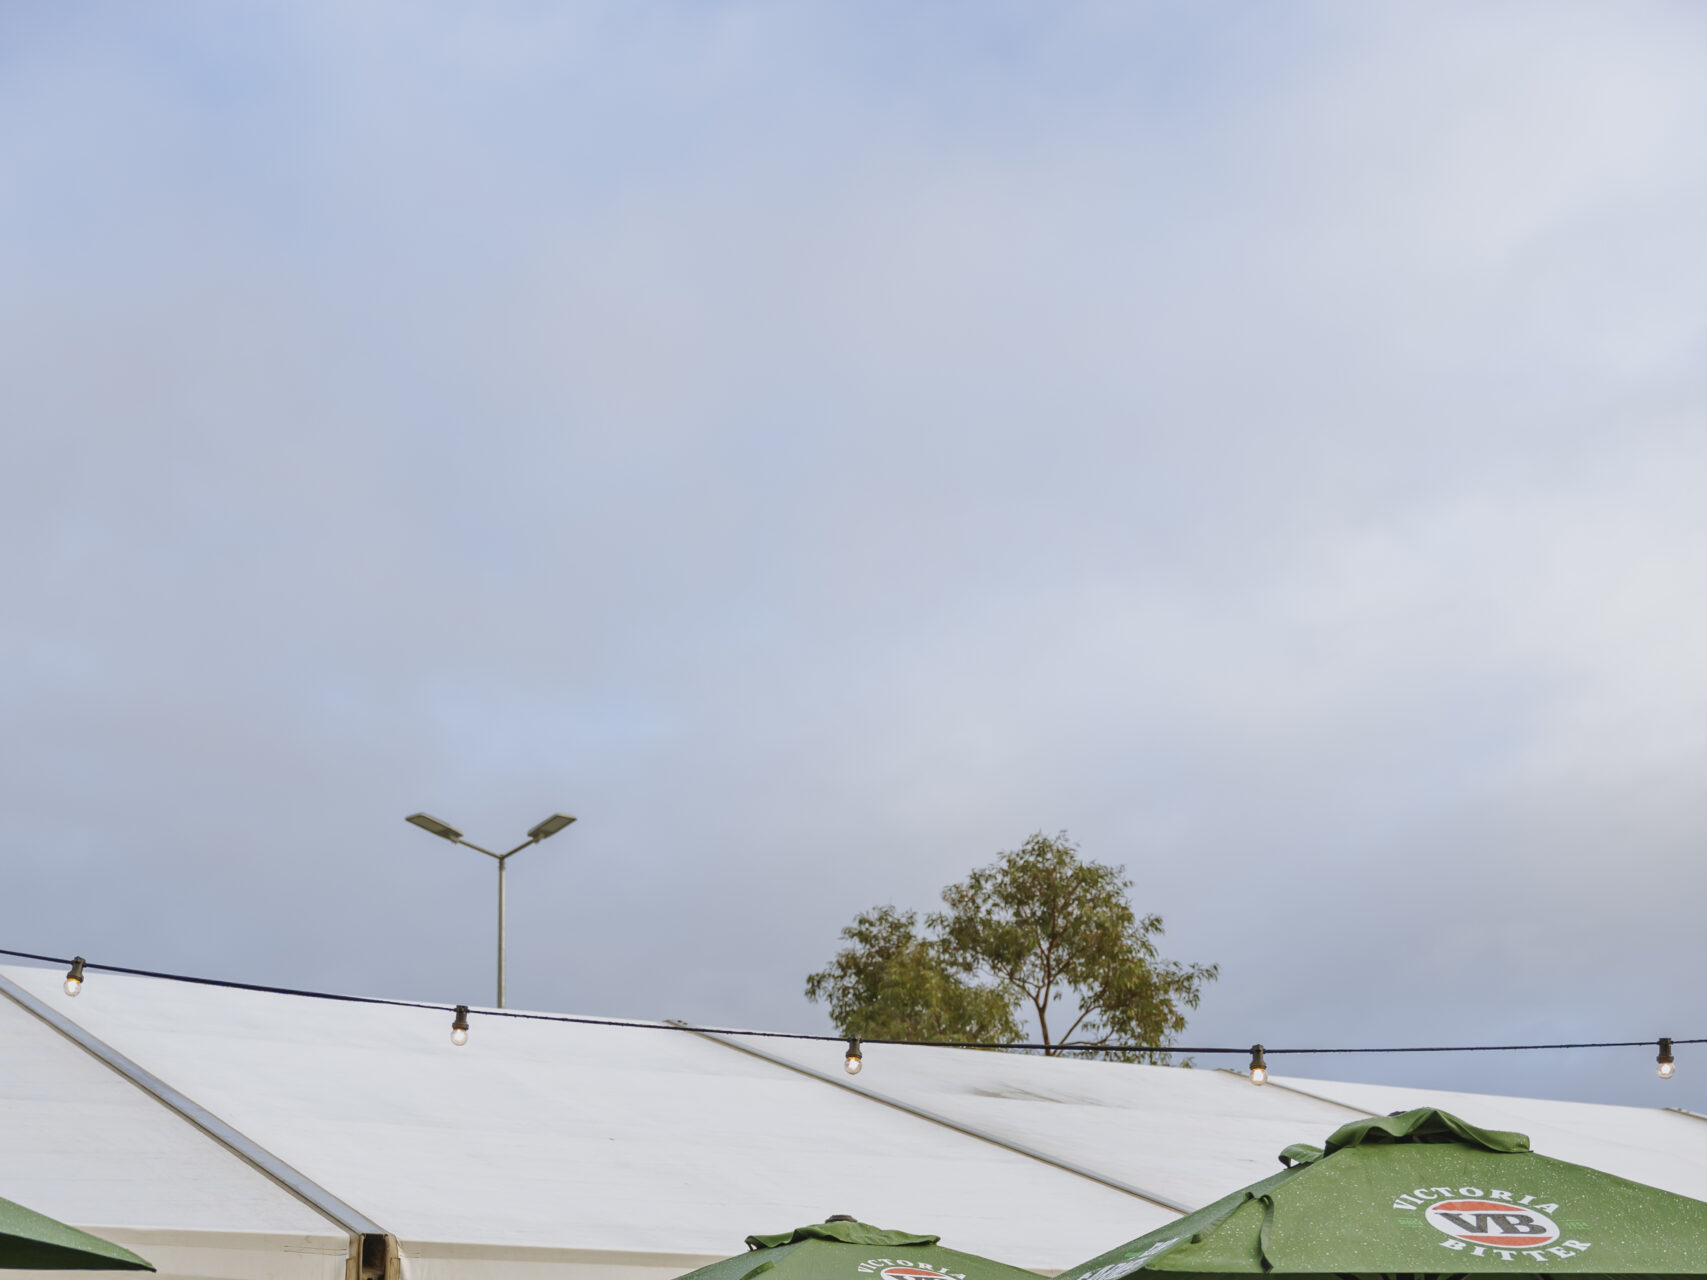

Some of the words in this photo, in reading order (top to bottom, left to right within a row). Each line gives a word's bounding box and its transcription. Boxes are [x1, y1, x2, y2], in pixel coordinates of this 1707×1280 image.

[1393, 1187, 1559, 1215] VICTORIA
[1433, 1212, 1547, 1234] VB
[1439, 1238, 1591, 1262] BITTER
[858, 1258, 967, 1280] VICTORIA
